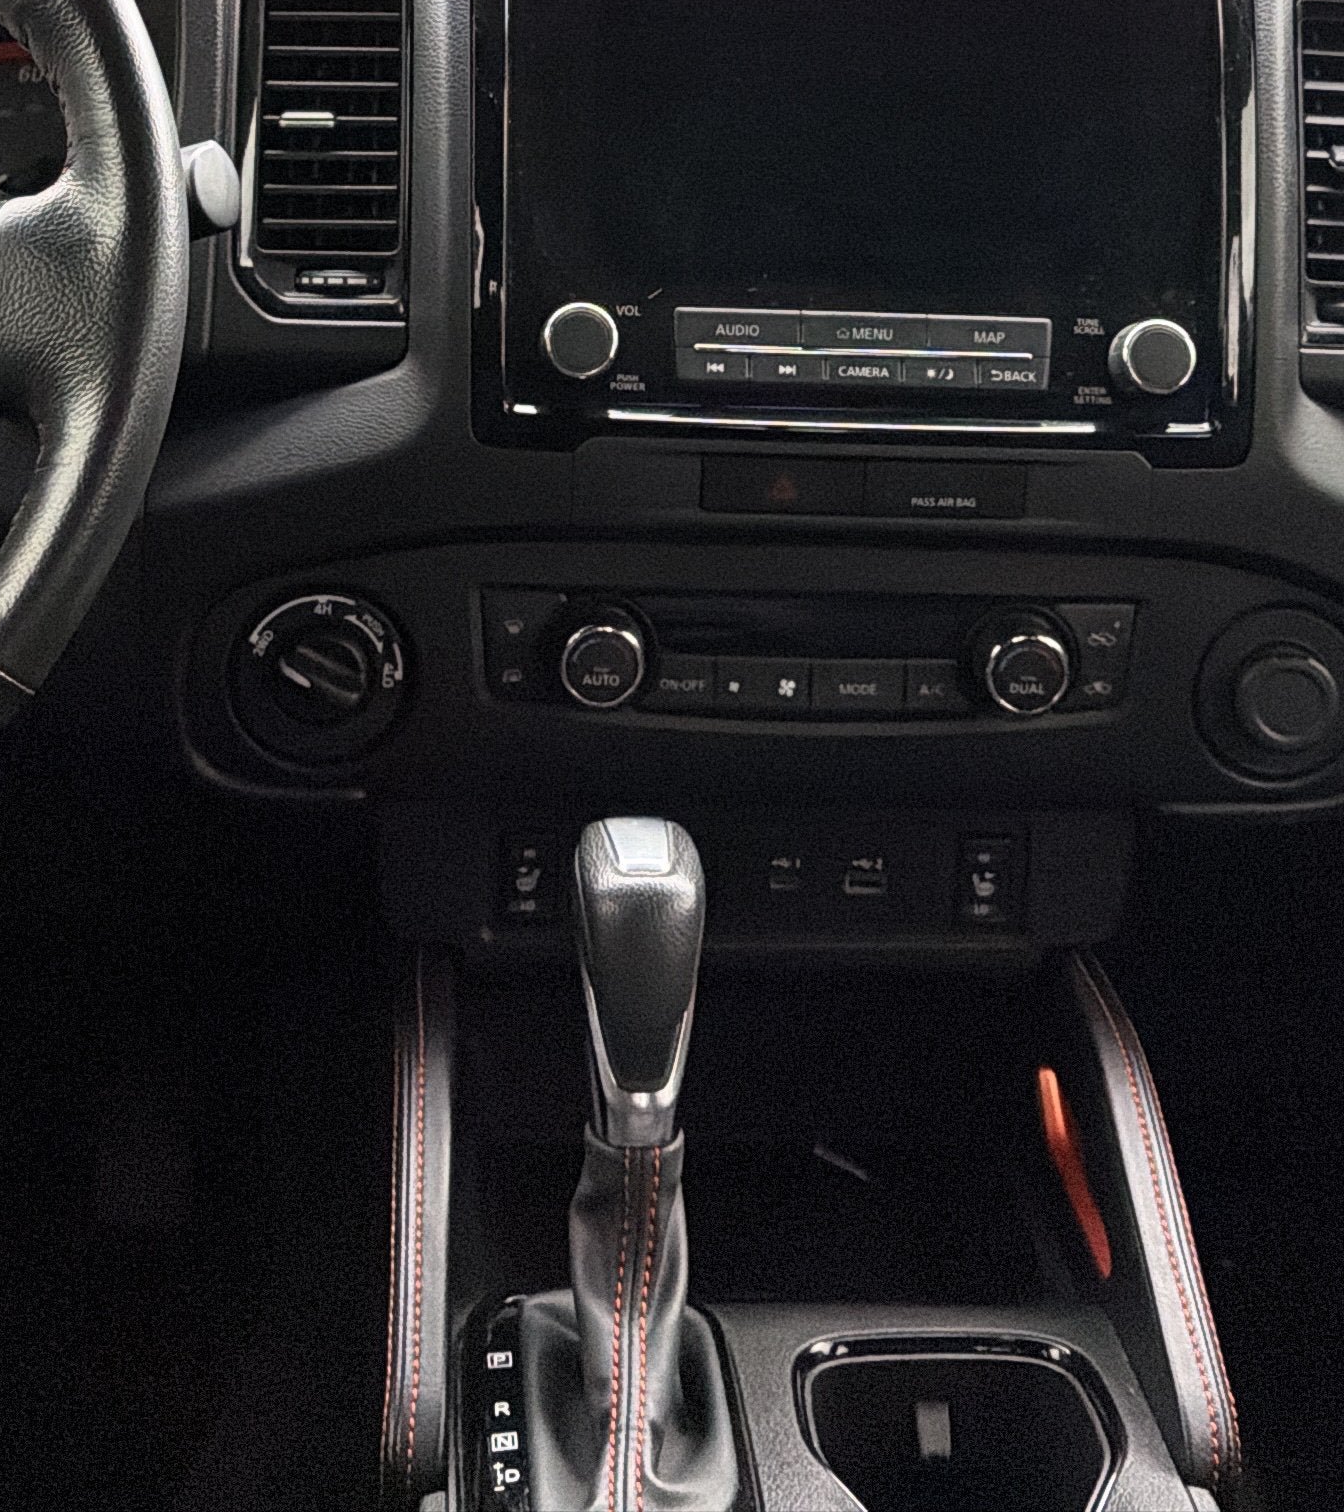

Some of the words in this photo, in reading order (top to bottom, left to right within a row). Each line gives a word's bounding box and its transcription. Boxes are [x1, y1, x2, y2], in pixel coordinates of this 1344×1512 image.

[615, 305, 642, 318] VOL
[715, 323, 760, 336] AUDIO
[852, 327, 894, 340] MENU
[973, 331, 1006, 345] MAP
[616, 373, 640, 383] PUSH
[838, 365, 890, 378] CAMERA
[1004, 370, 1037, 383] BACK
[609, 381, 646, 392] POWER
[313, 602, 334, 616] 4H
[581, 673, 621, 687] AUTO
[838, 682, 878, 696] MODE
[1008, 682, 1046, 696] DUAL
[493, 1400, 511, 1418] R
[504, 1468, 521, 1484] D
